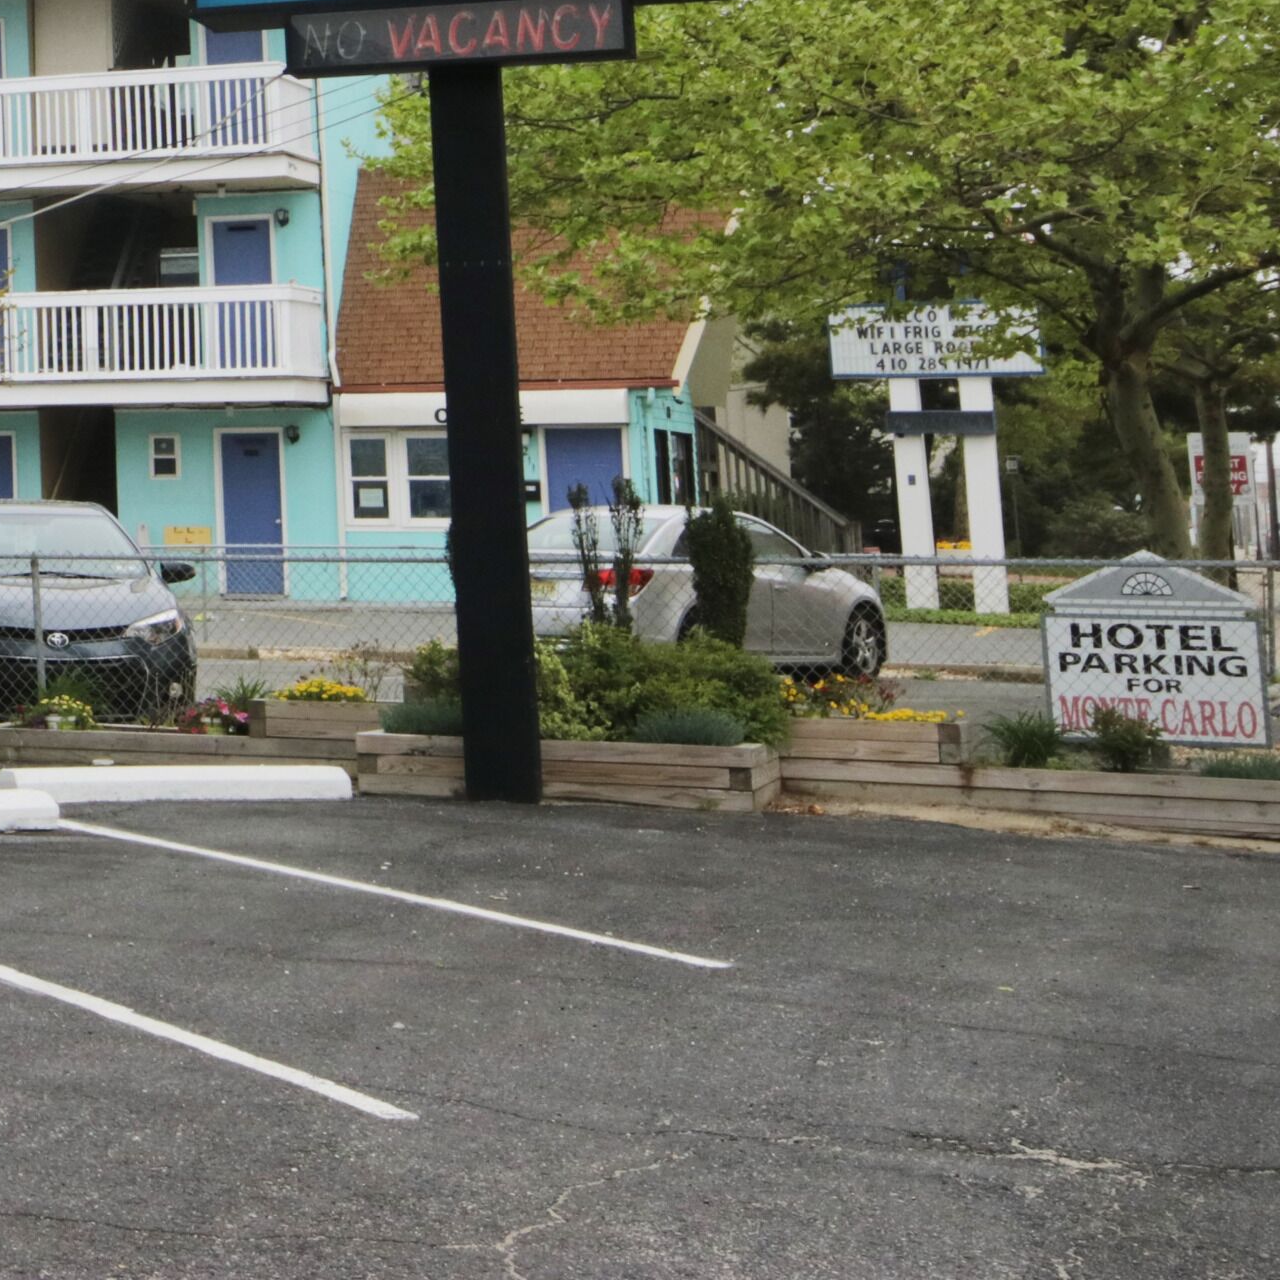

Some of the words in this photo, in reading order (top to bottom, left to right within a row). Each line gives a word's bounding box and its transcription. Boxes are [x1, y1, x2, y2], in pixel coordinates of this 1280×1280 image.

[304, 20, 367, 60] NO
[387, 3, 612, 59] VACANCY
[904, 325, 941, 339] FRIG
[870, 341, 923, 355] LARGE
[876, 358, 907, 370] 410
[1070, 623, 1238, 652] HOTEL
[1058, 652, 1248, 677] PARKING
[1127, 678, 1182, 693] FOR
[1161, 698, 1258, 738] CARLO
